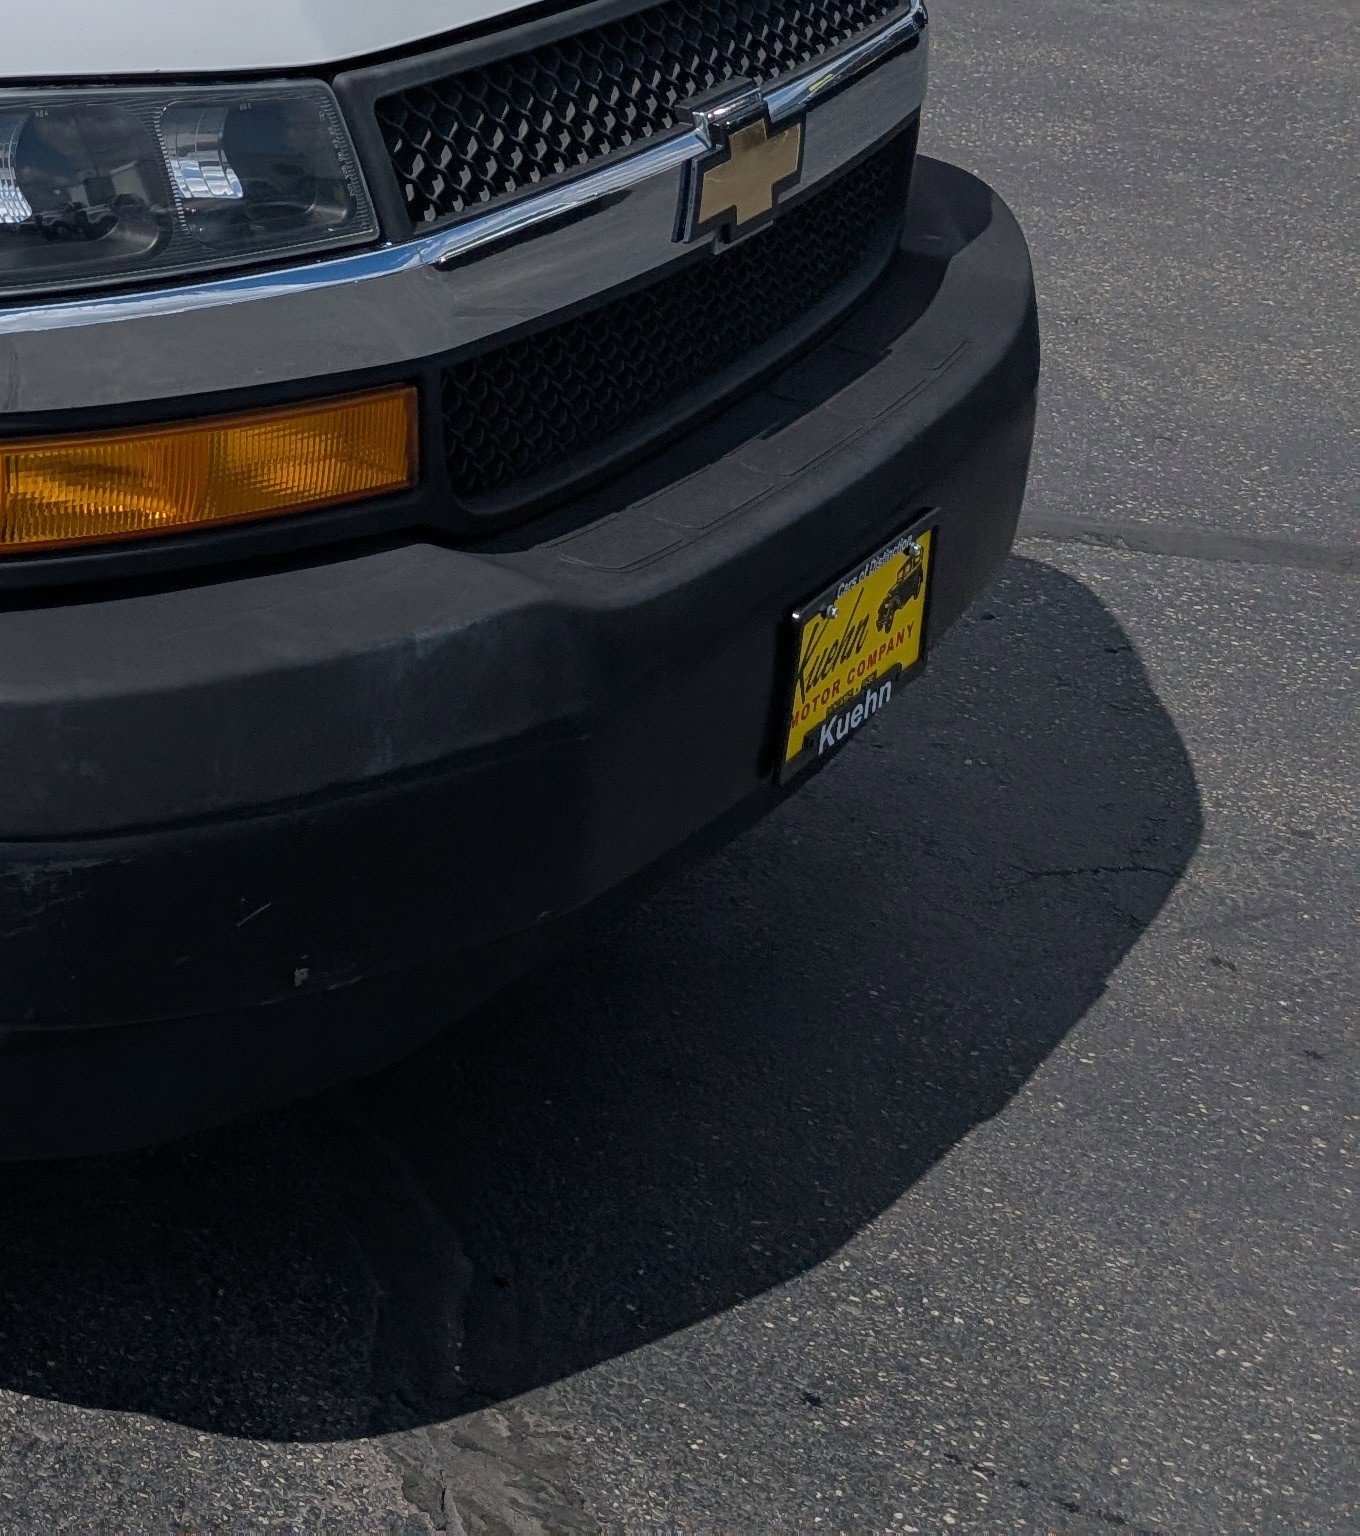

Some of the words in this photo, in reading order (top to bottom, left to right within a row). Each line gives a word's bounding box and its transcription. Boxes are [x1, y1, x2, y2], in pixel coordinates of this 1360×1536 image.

[791, 678, 841, 729] MOTOR
[846, 620, 915, 685] COMPANY
[817, 680, 892, 756] Kuehn
